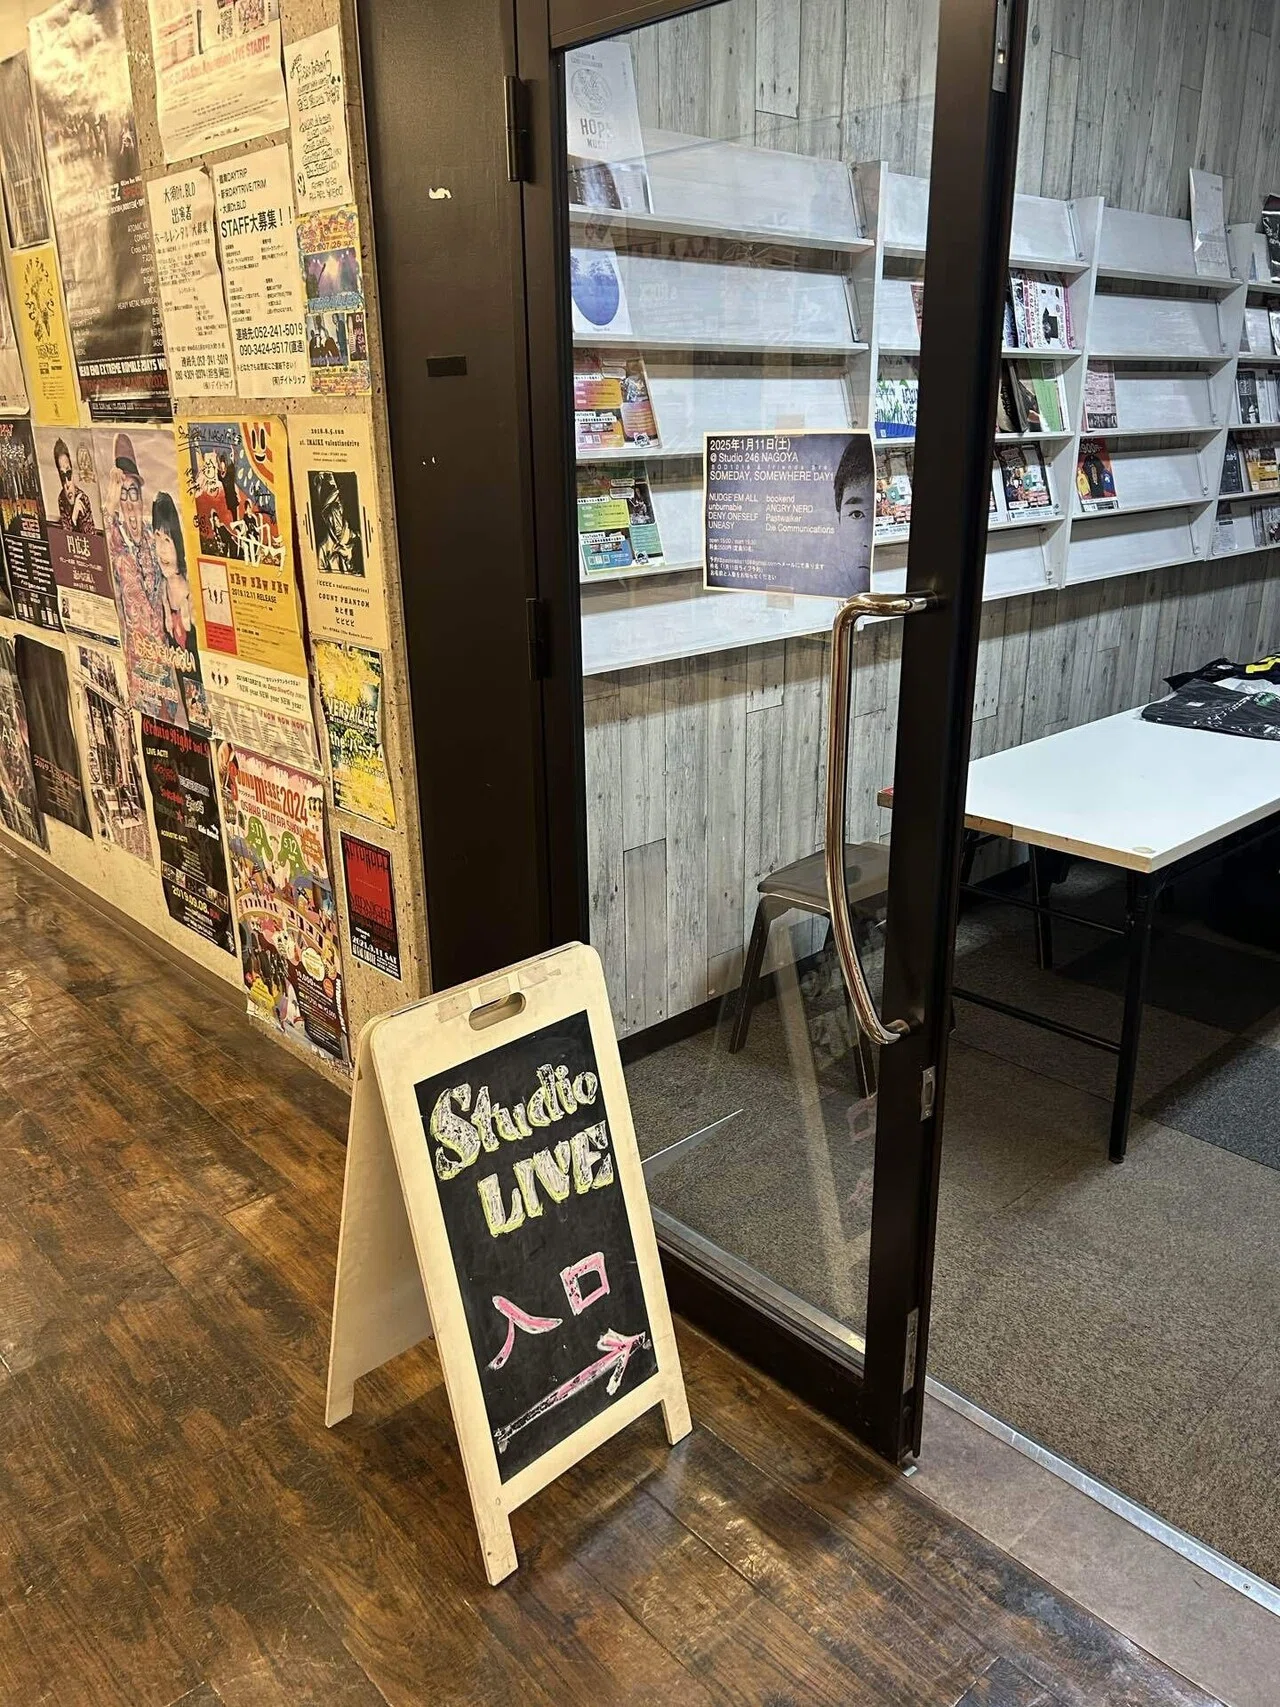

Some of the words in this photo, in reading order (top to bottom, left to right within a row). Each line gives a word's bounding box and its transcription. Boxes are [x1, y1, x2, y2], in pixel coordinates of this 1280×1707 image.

[171, 204, 192, 224] 出演者
[710, 438, 791, 452] 2025年1月11日(土)
[719, 453, 743, 463] Studio
[745, 452, 759, 463] 246
[761, 452, 799, 462] NAGOYA
[754, 470, 811, 481] SOMEWHERE
[766, 495, 795, 503] bookend
[766, 505, 791, 514] ANGRY
[709, 521, 735, 530] UNEASY
[778, 524, 835, 534] Communications
[256, 593, 277, 604] RELEASE
[280, 786, 308, 826] 2024
[430, 1064, 598, 1181] Studio
[477, 1120, 614, 1237] LIVE
[486, 1251, 611, 1371] 入口
